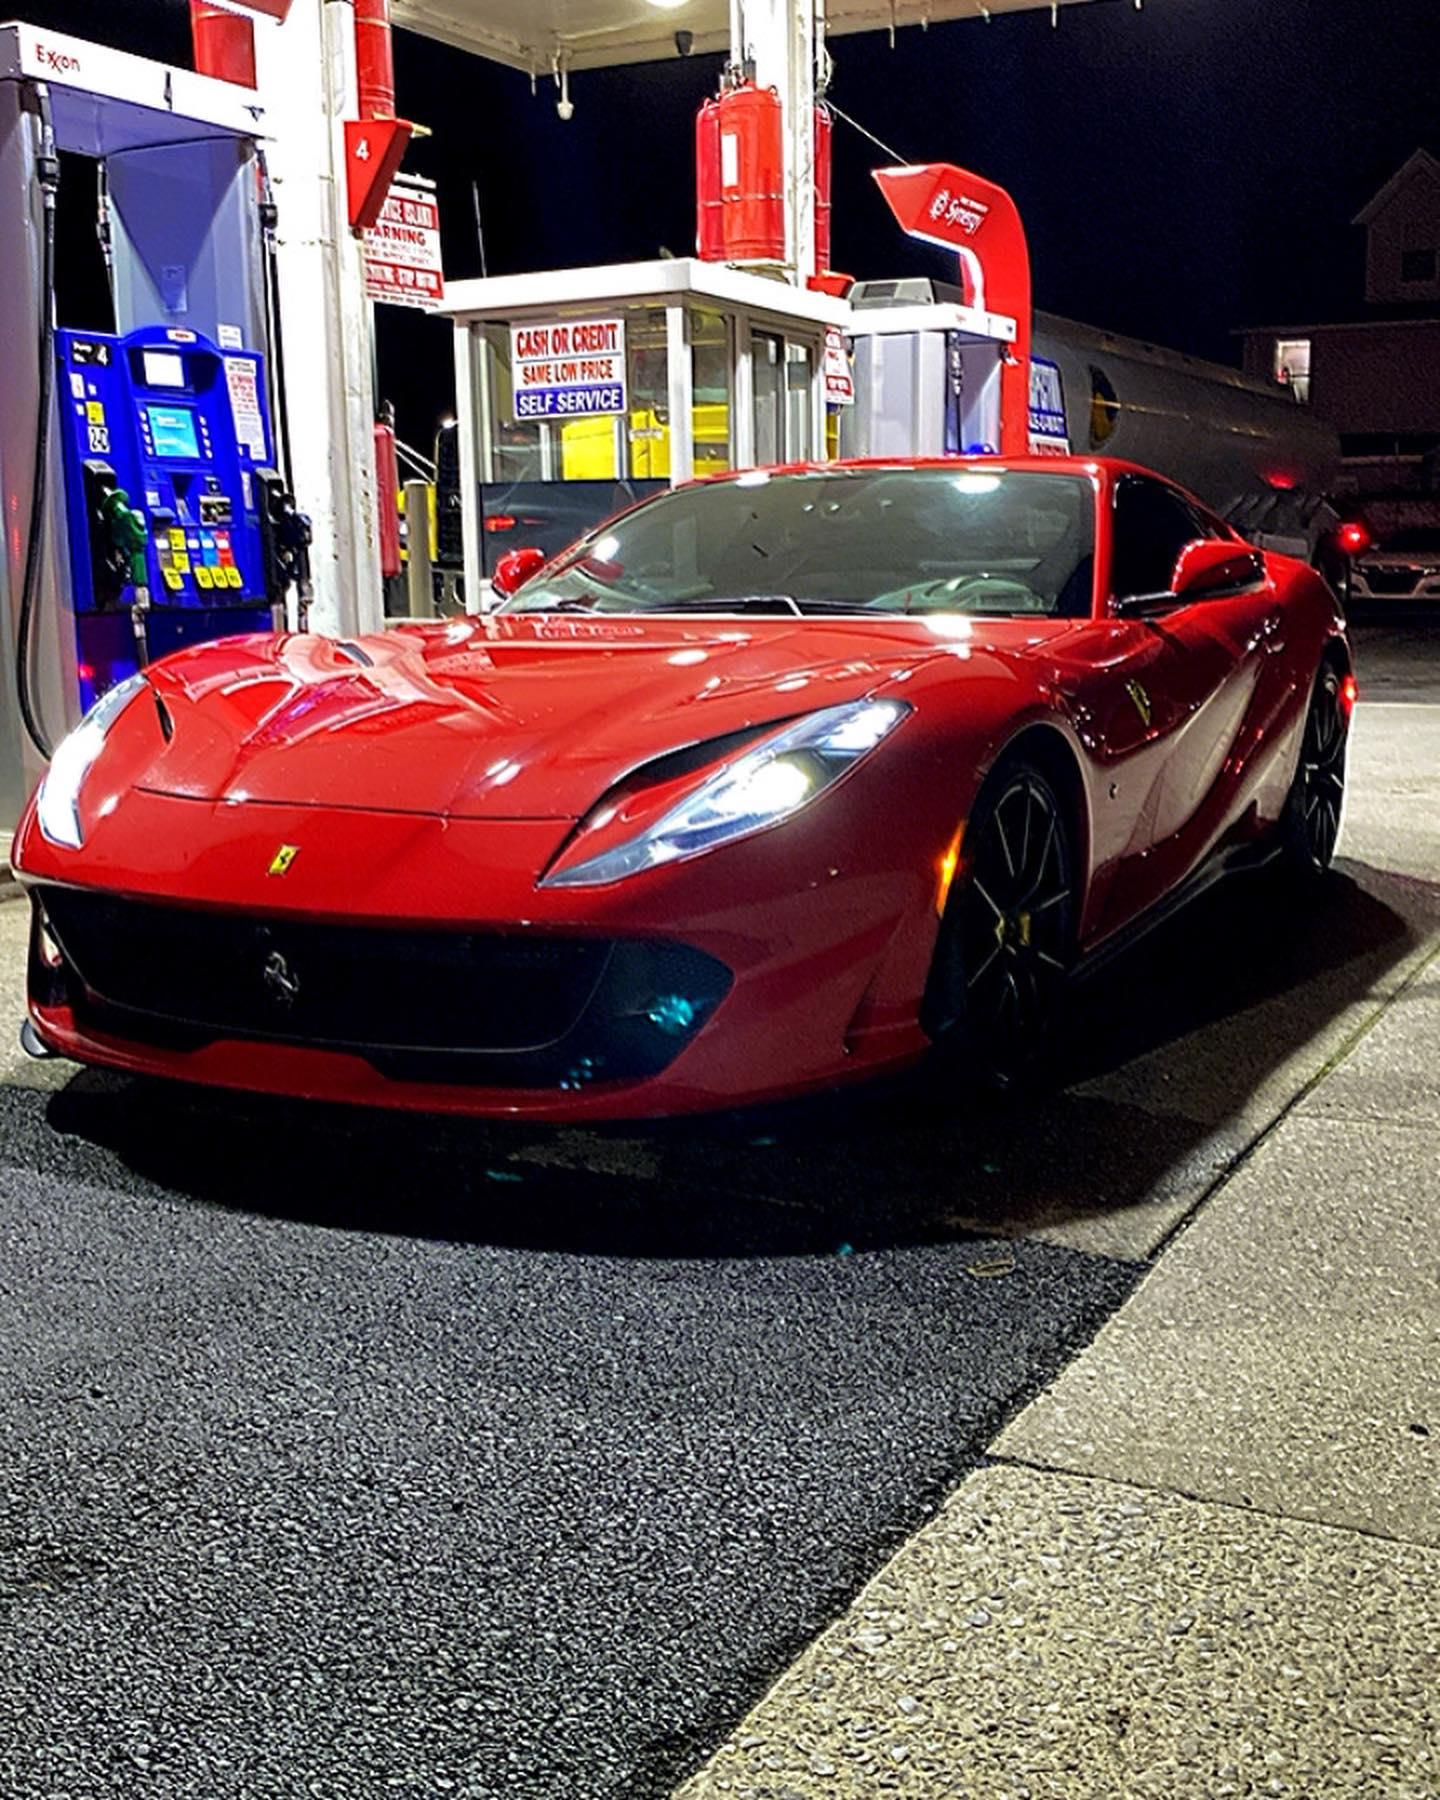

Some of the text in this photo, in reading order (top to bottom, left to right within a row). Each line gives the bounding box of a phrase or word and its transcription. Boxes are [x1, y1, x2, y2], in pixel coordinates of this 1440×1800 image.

[36, 43, 81, 74] Exxon
[356, 138, 370, 161] 4
[367, 224, 427, 247] ARNING
[517, 323, 618, 358] CASH OR CREDIT
[97, 345, 109, 367] 4
[523, 359, 613, 385] SAME LOW PRICE
[519, 389, 621, 415] SELF SERVICE
